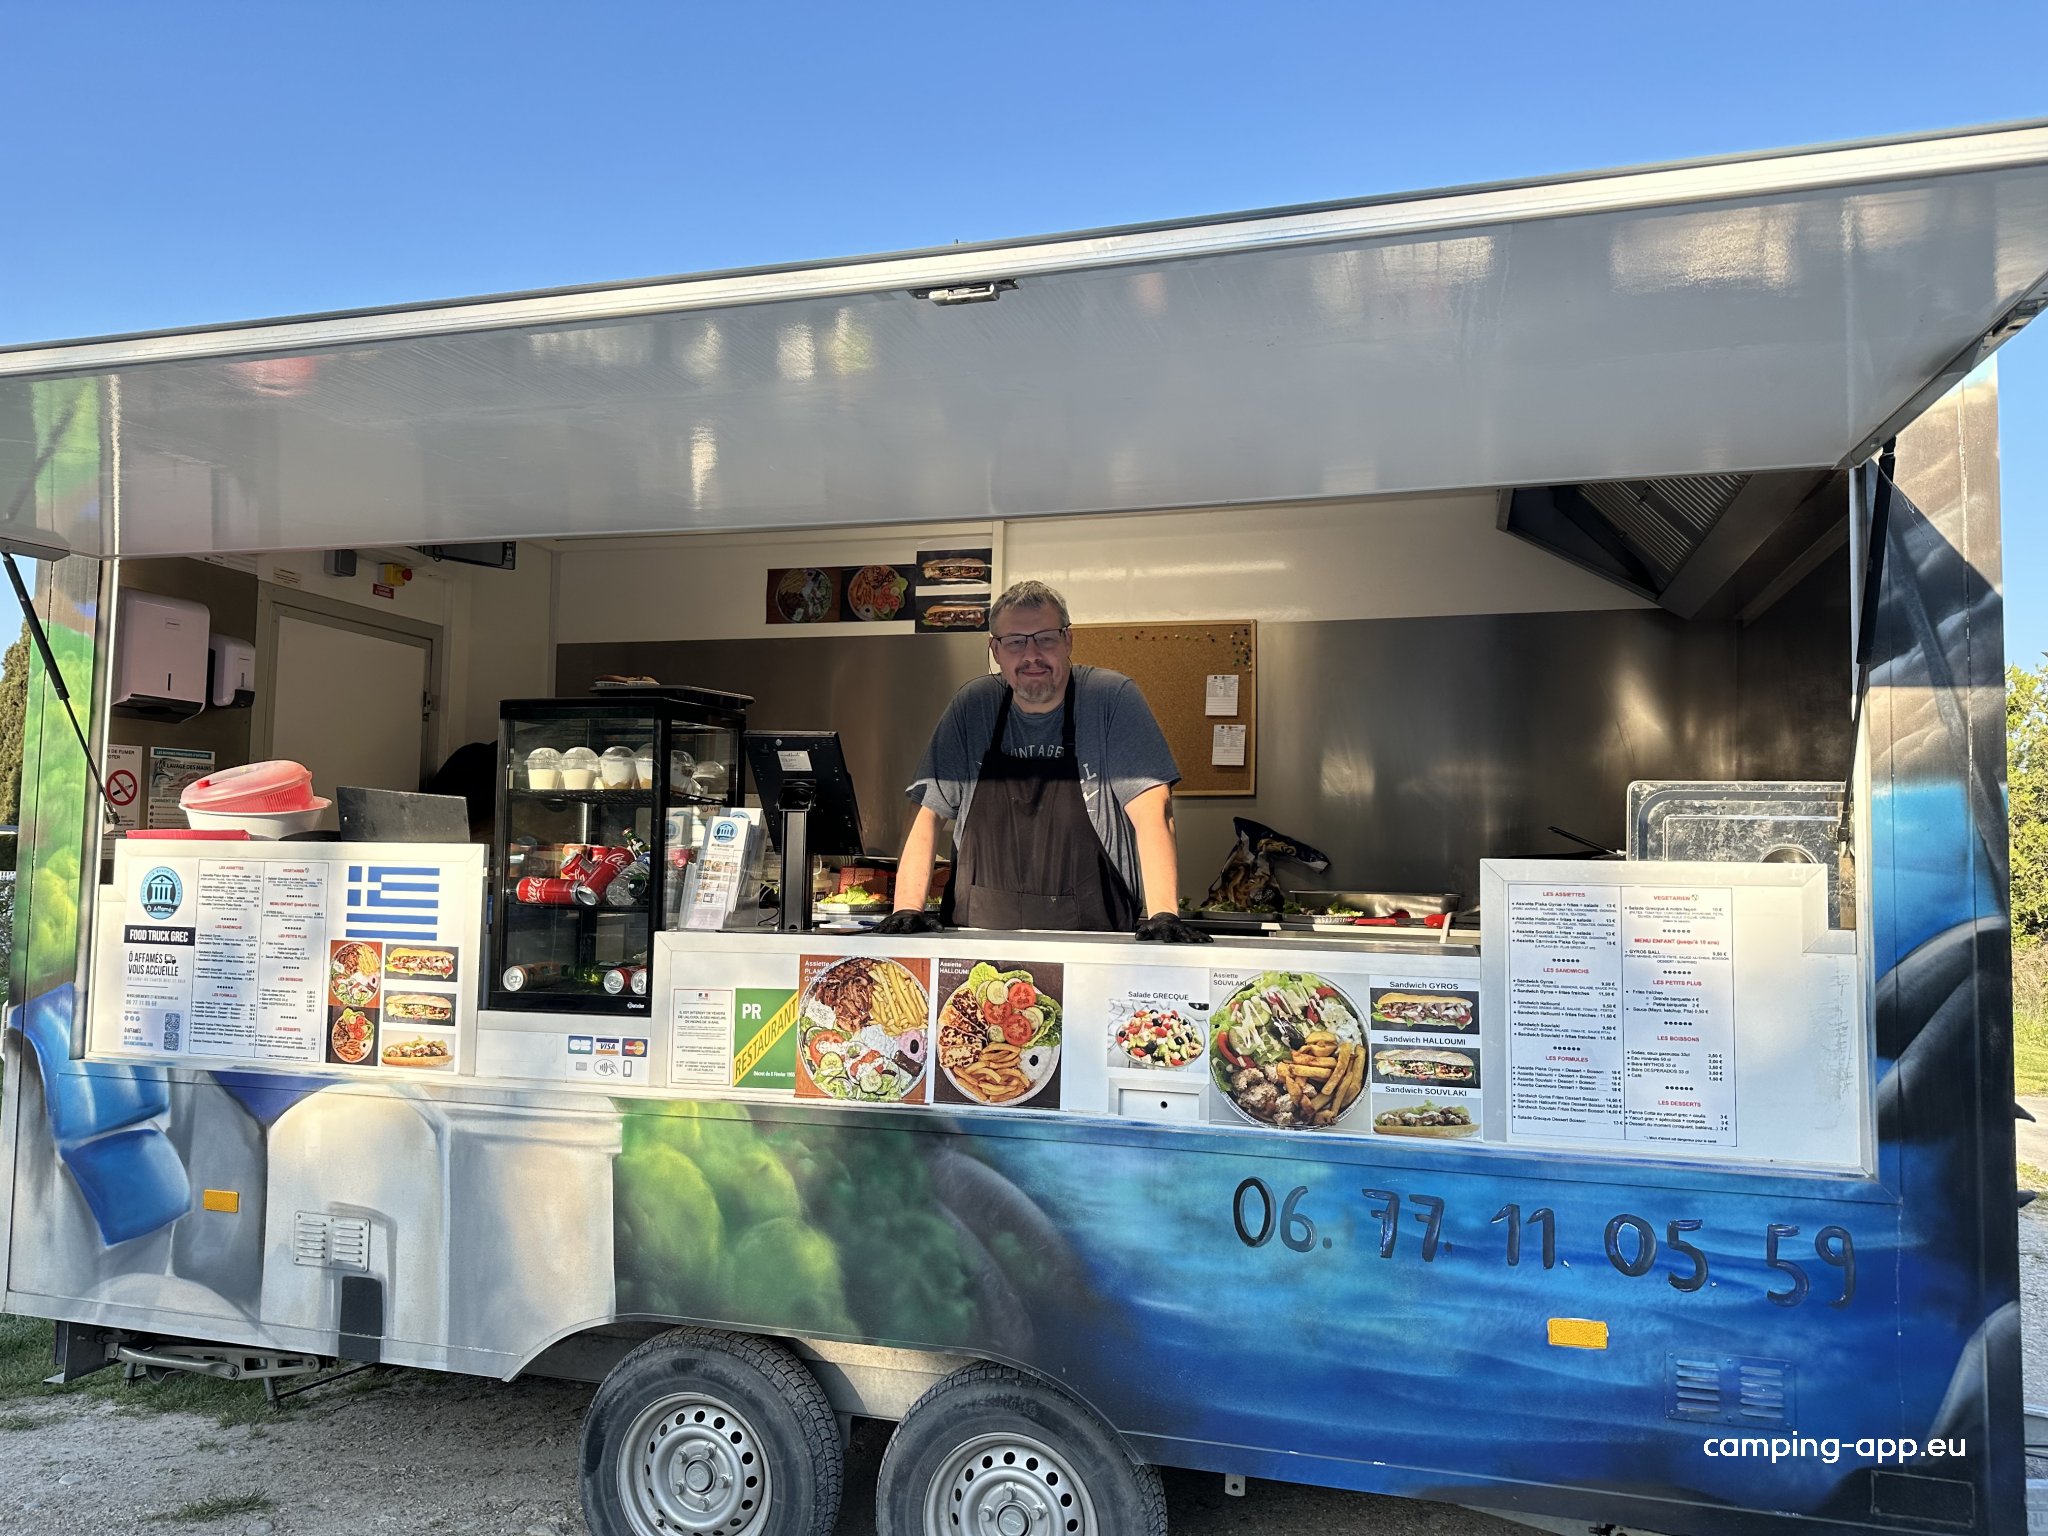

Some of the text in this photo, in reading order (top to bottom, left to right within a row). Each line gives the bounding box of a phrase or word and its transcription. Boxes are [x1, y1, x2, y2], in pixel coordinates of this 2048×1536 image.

[130, 929, 188, 943] FOOD TRUCK GREC
[129, 951, 163, 964] Ô AFFAMÉS
[128, 964, 178, 976] VOUS ACCUEILLE
[1389, 981, 1428, 989] Sandwich
[1128, 991, 1190, 1001] Salade GRECQUE
[742, 1004, 761, 1019] PR
[735, 998, 797, 1079] RESTAURANT
[1383, 1036, 1466, 1046] Sandwich HALLOUMI
[1385, 1086, 1468, 1097] Sandwich SOUVLAKI
[1232, 1176, 1332, 1254] 06.
[1765, 1222, 1857, 1311] 59
